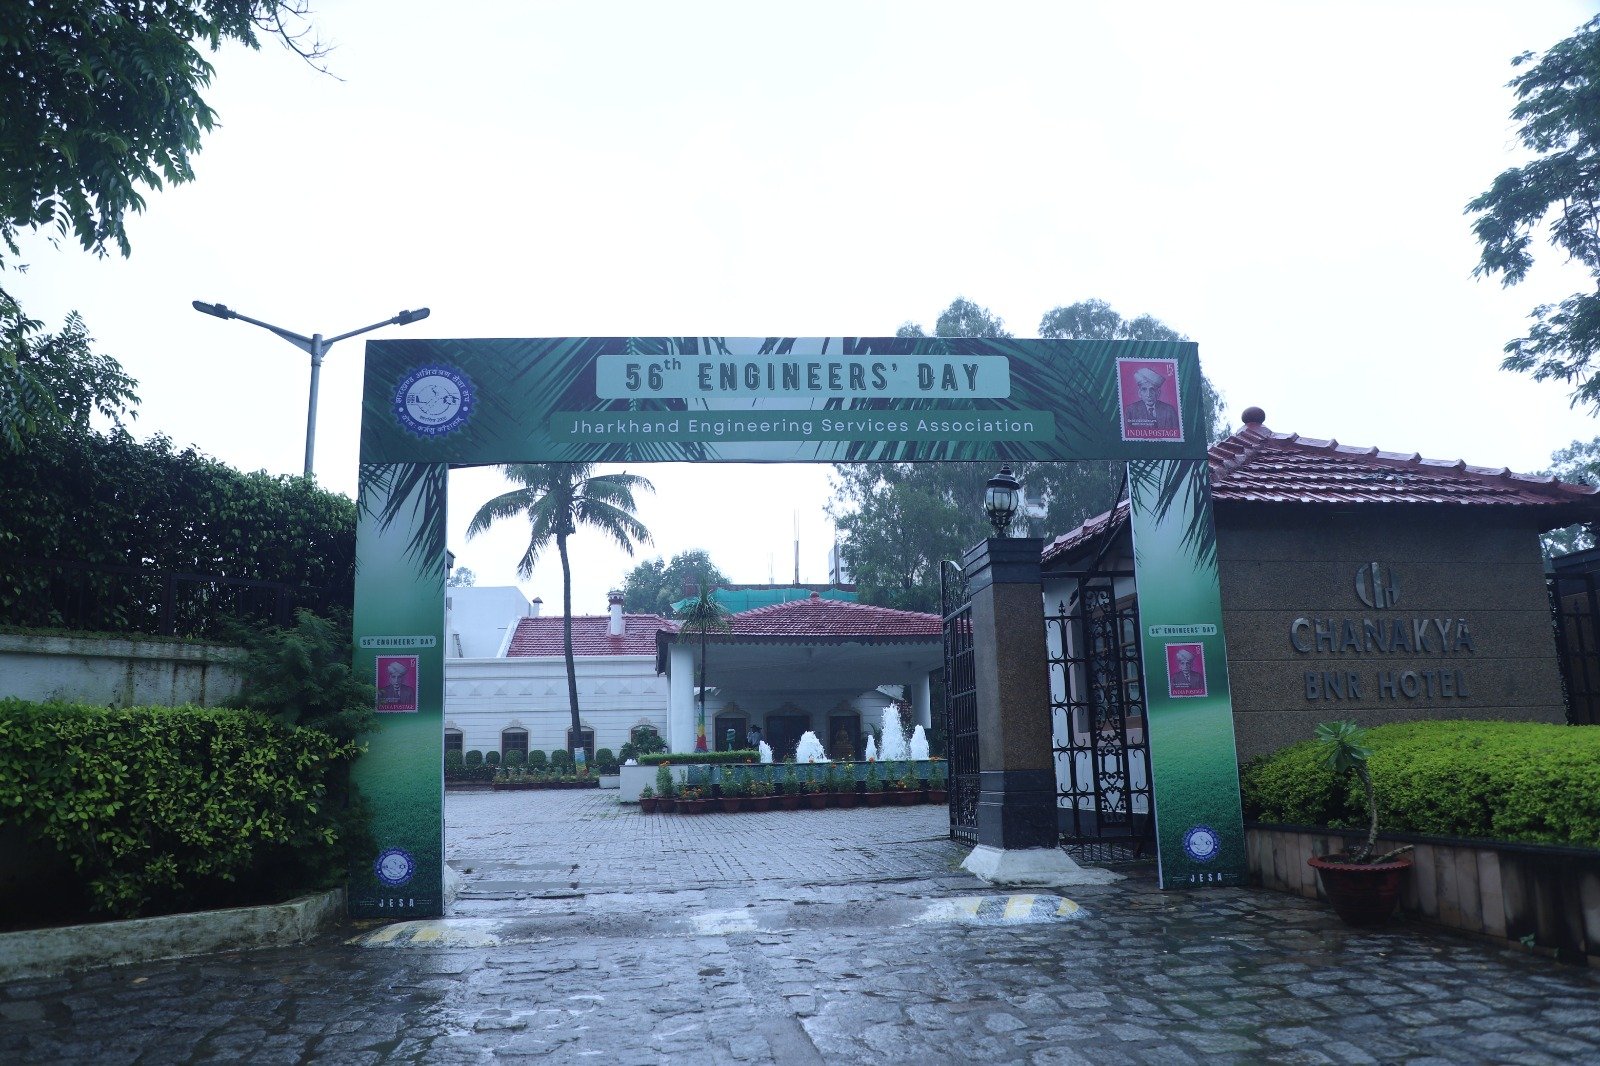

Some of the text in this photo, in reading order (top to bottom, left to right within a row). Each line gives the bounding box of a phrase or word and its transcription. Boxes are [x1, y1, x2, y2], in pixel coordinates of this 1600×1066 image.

[625, 358, 979, 391] 56th ENGINEERS' DAY
[570, 418, 1034, 436] Jharkhand Engineering Services Association
[1127, 429, 1178, 437] INDIA POSTAGE
[1290, 617, 1475, 653] CHANAKYA
[1303, 669, 1470, 700] BNR HOTEL
[1190, 872, 1222, 883] JESA
[379, 898, 414, 908] JESA
